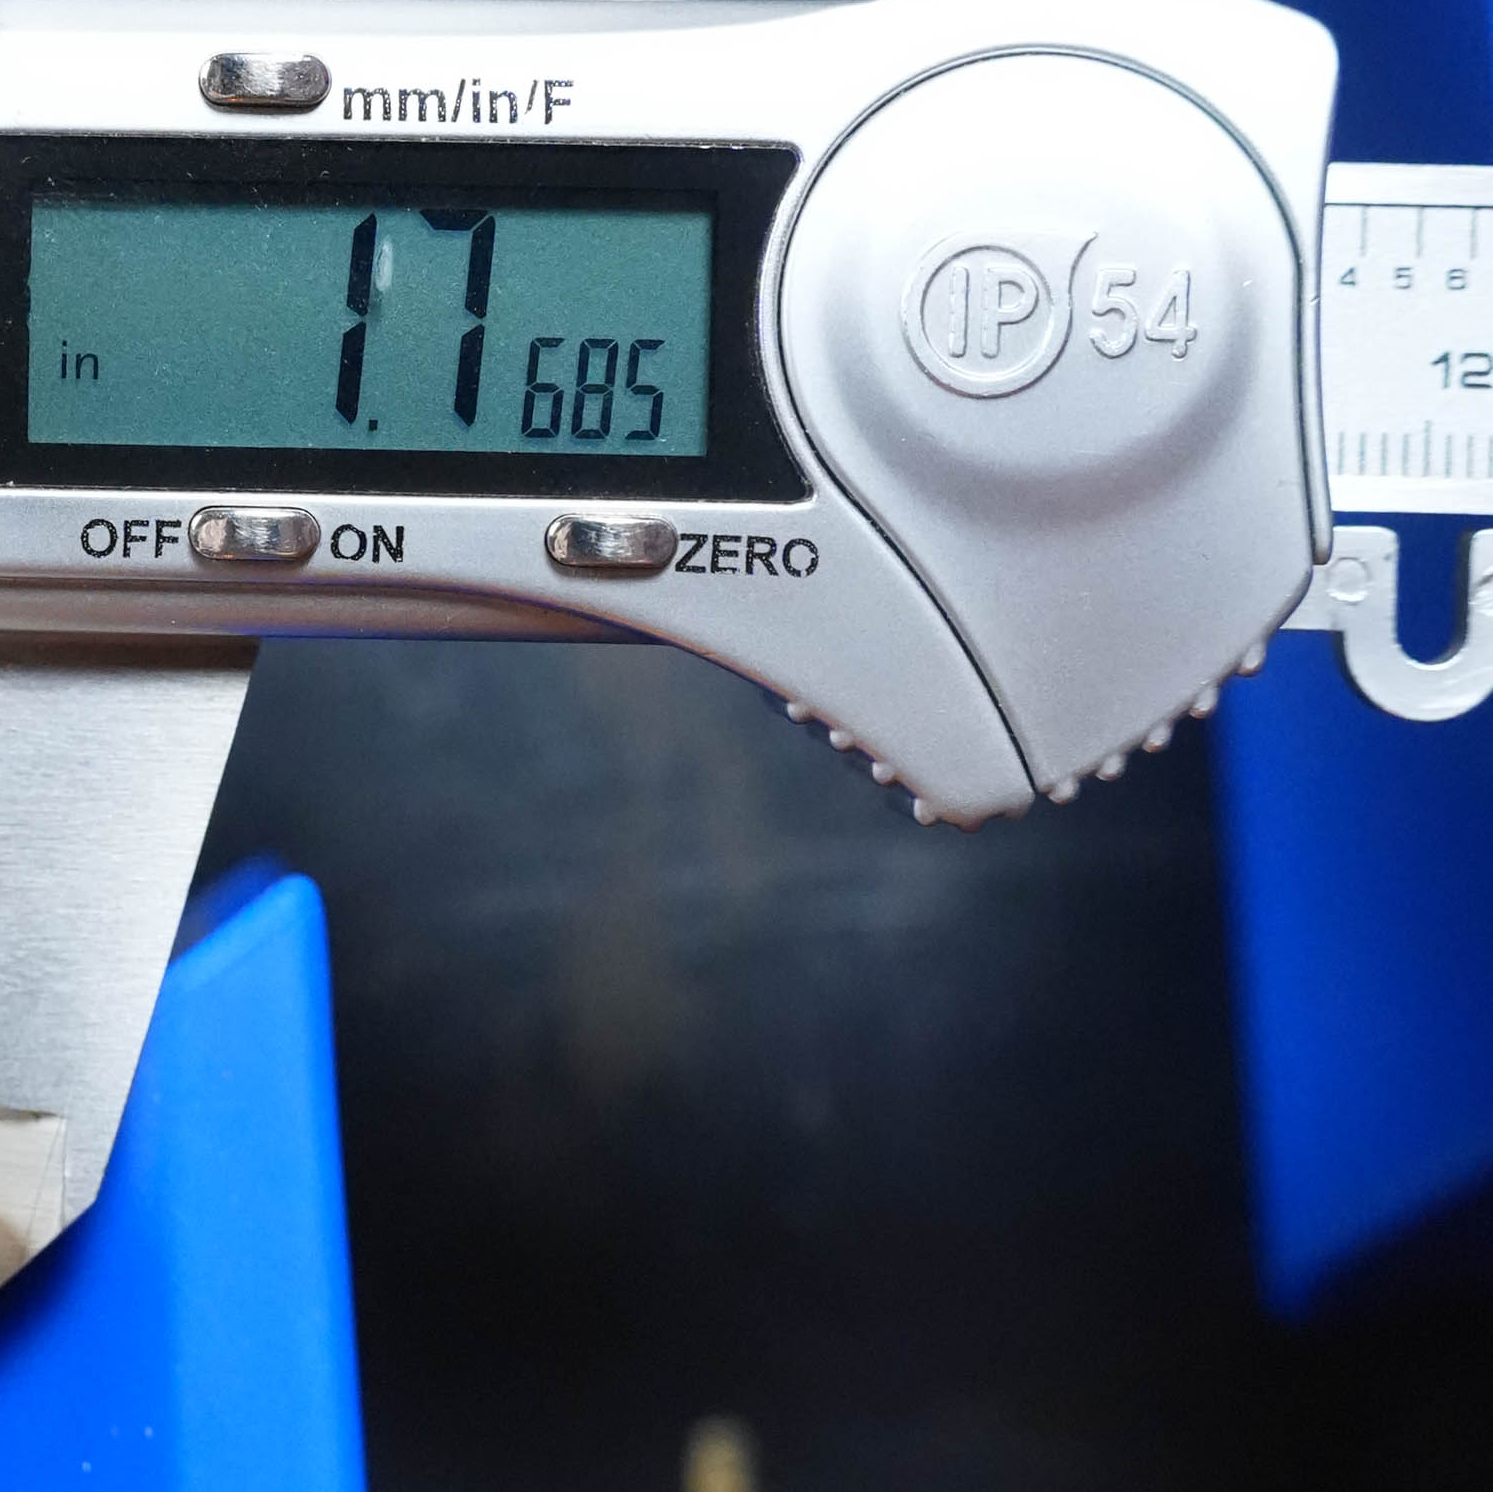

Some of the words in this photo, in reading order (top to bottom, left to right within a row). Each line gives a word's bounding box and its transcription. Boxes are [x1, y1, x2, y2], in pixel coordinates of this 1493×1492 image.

[341, 78, 574, 126] mm/in/F
[1338, 266, 1358, 288] 4
[1393, 266, 1414, 290] 5
[948, 265, 1040, 358] IP
[1089, 267, 1198, 360] 54
[60, 340, 100, 381] in
[80, 519, 183, 560] OFF
[330, 524, 405, 564] ON
[675, 533, 819, 578] ZERO
